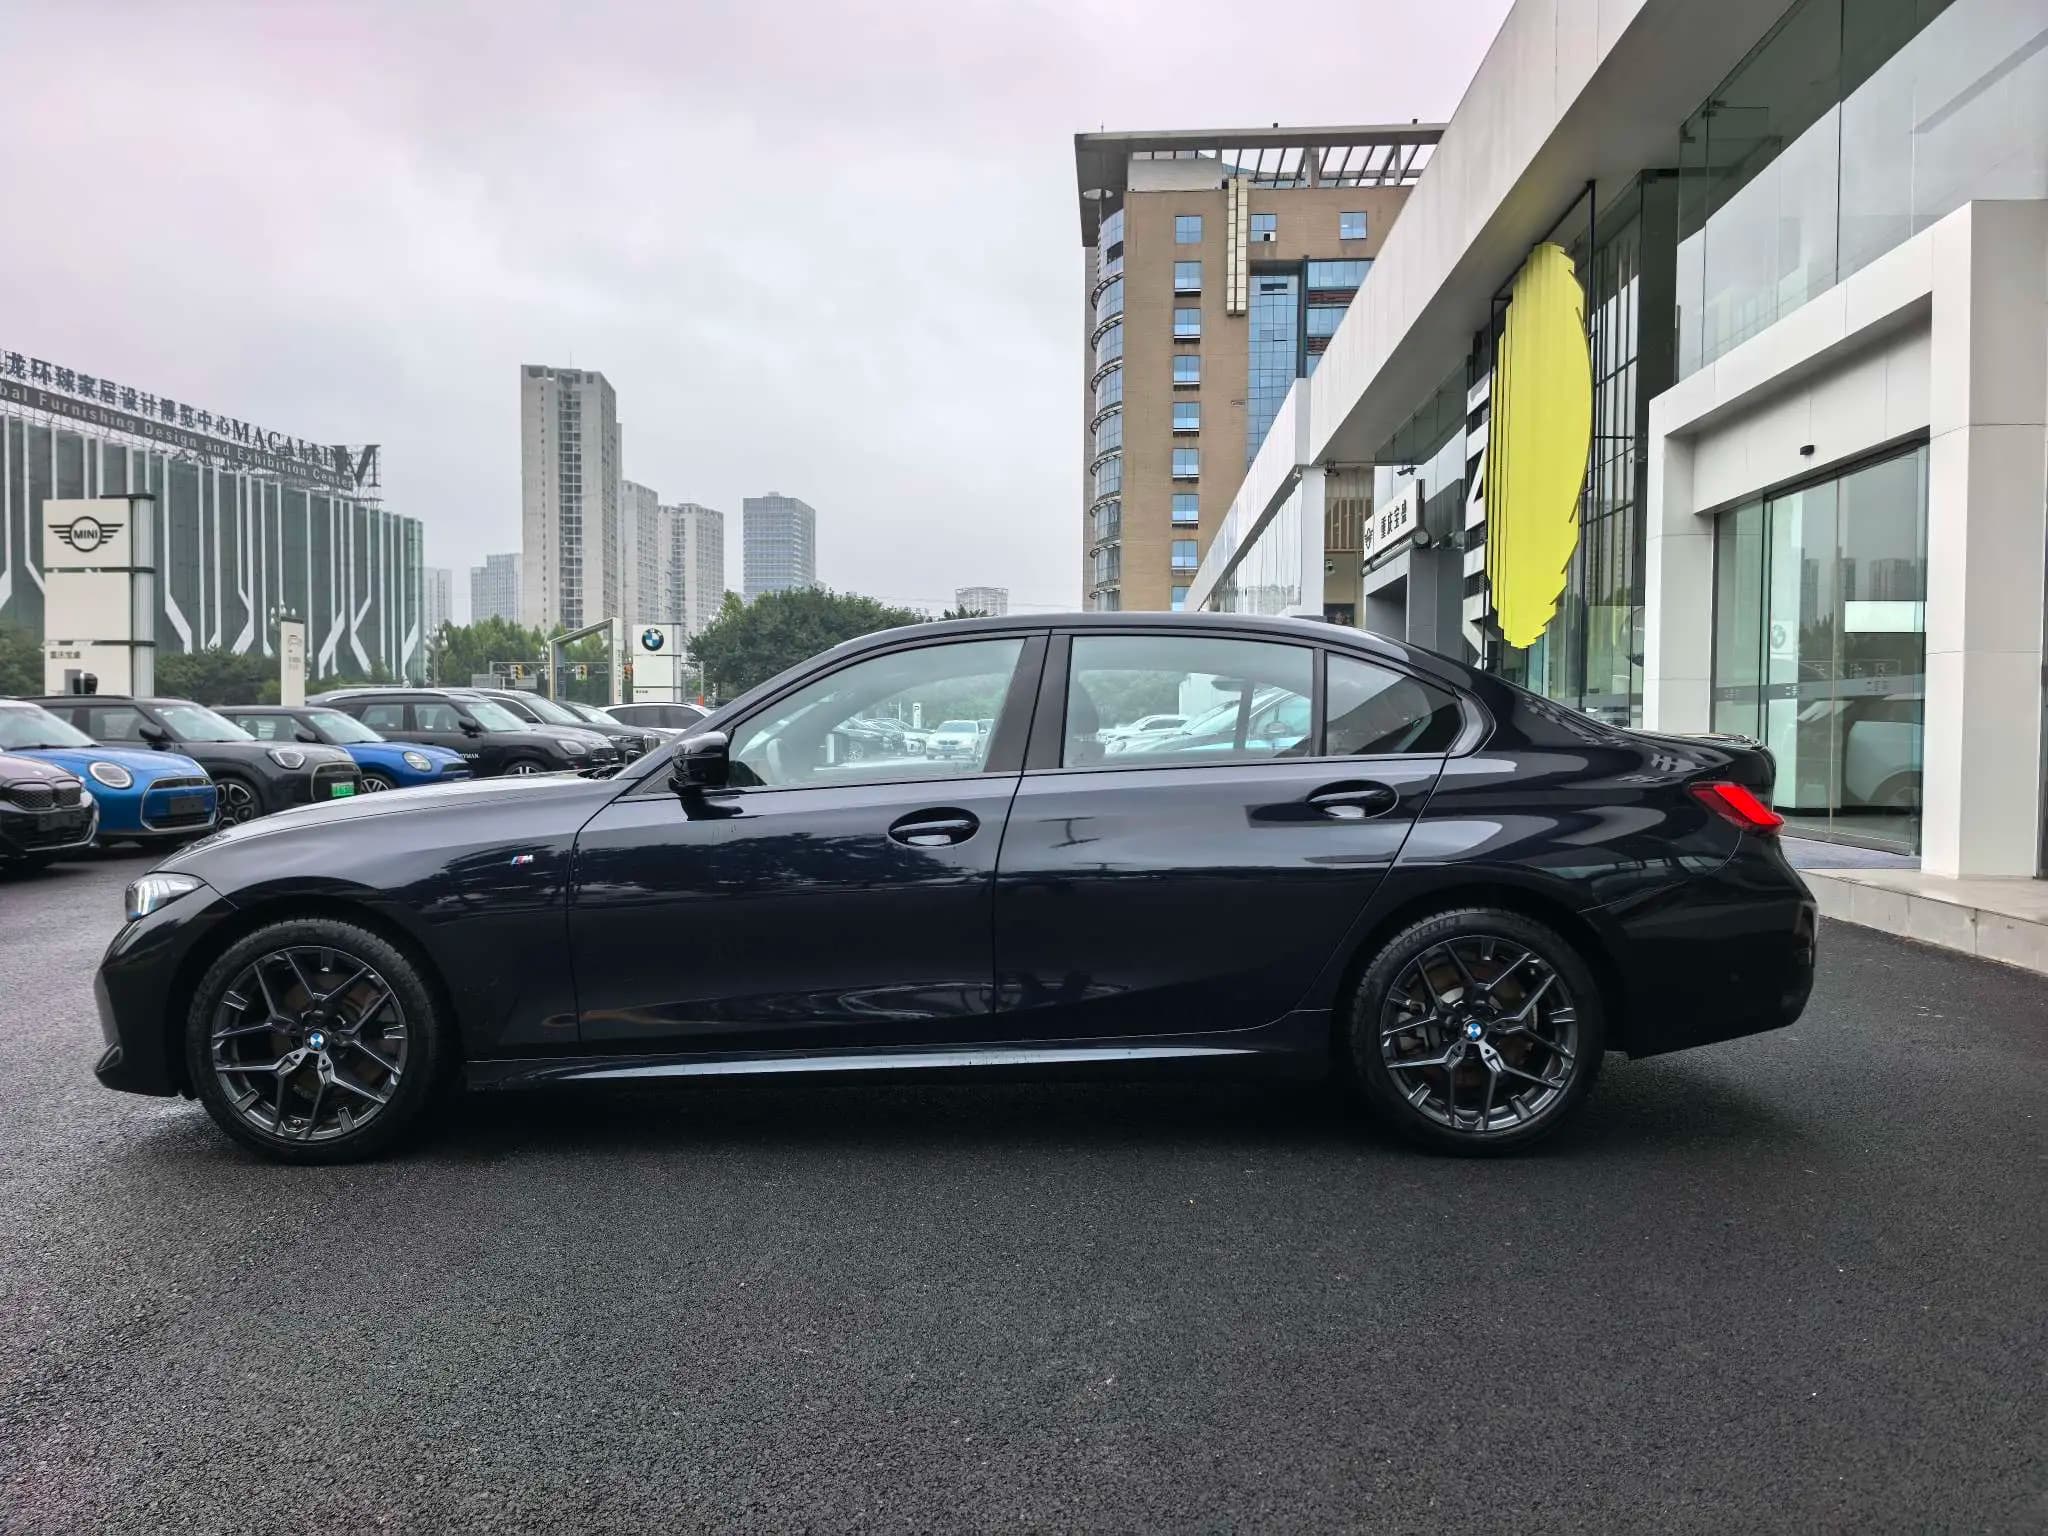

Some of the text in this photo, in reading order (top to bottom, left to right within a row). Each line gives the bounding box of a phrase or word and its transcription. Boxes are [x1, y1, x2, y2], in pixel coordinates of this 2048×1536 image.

[0, 352, 230, 436] 龙环球家居设计博览中心
[39, 392, 136, 433] Furnishing
[144, 422, 197, 448] Design
[205, 441, 230, 456] and
[238, 447, 306, 476] Exhibition
[312, 468, 353, 488] Center
[74, 529, 98, 539] MINI
